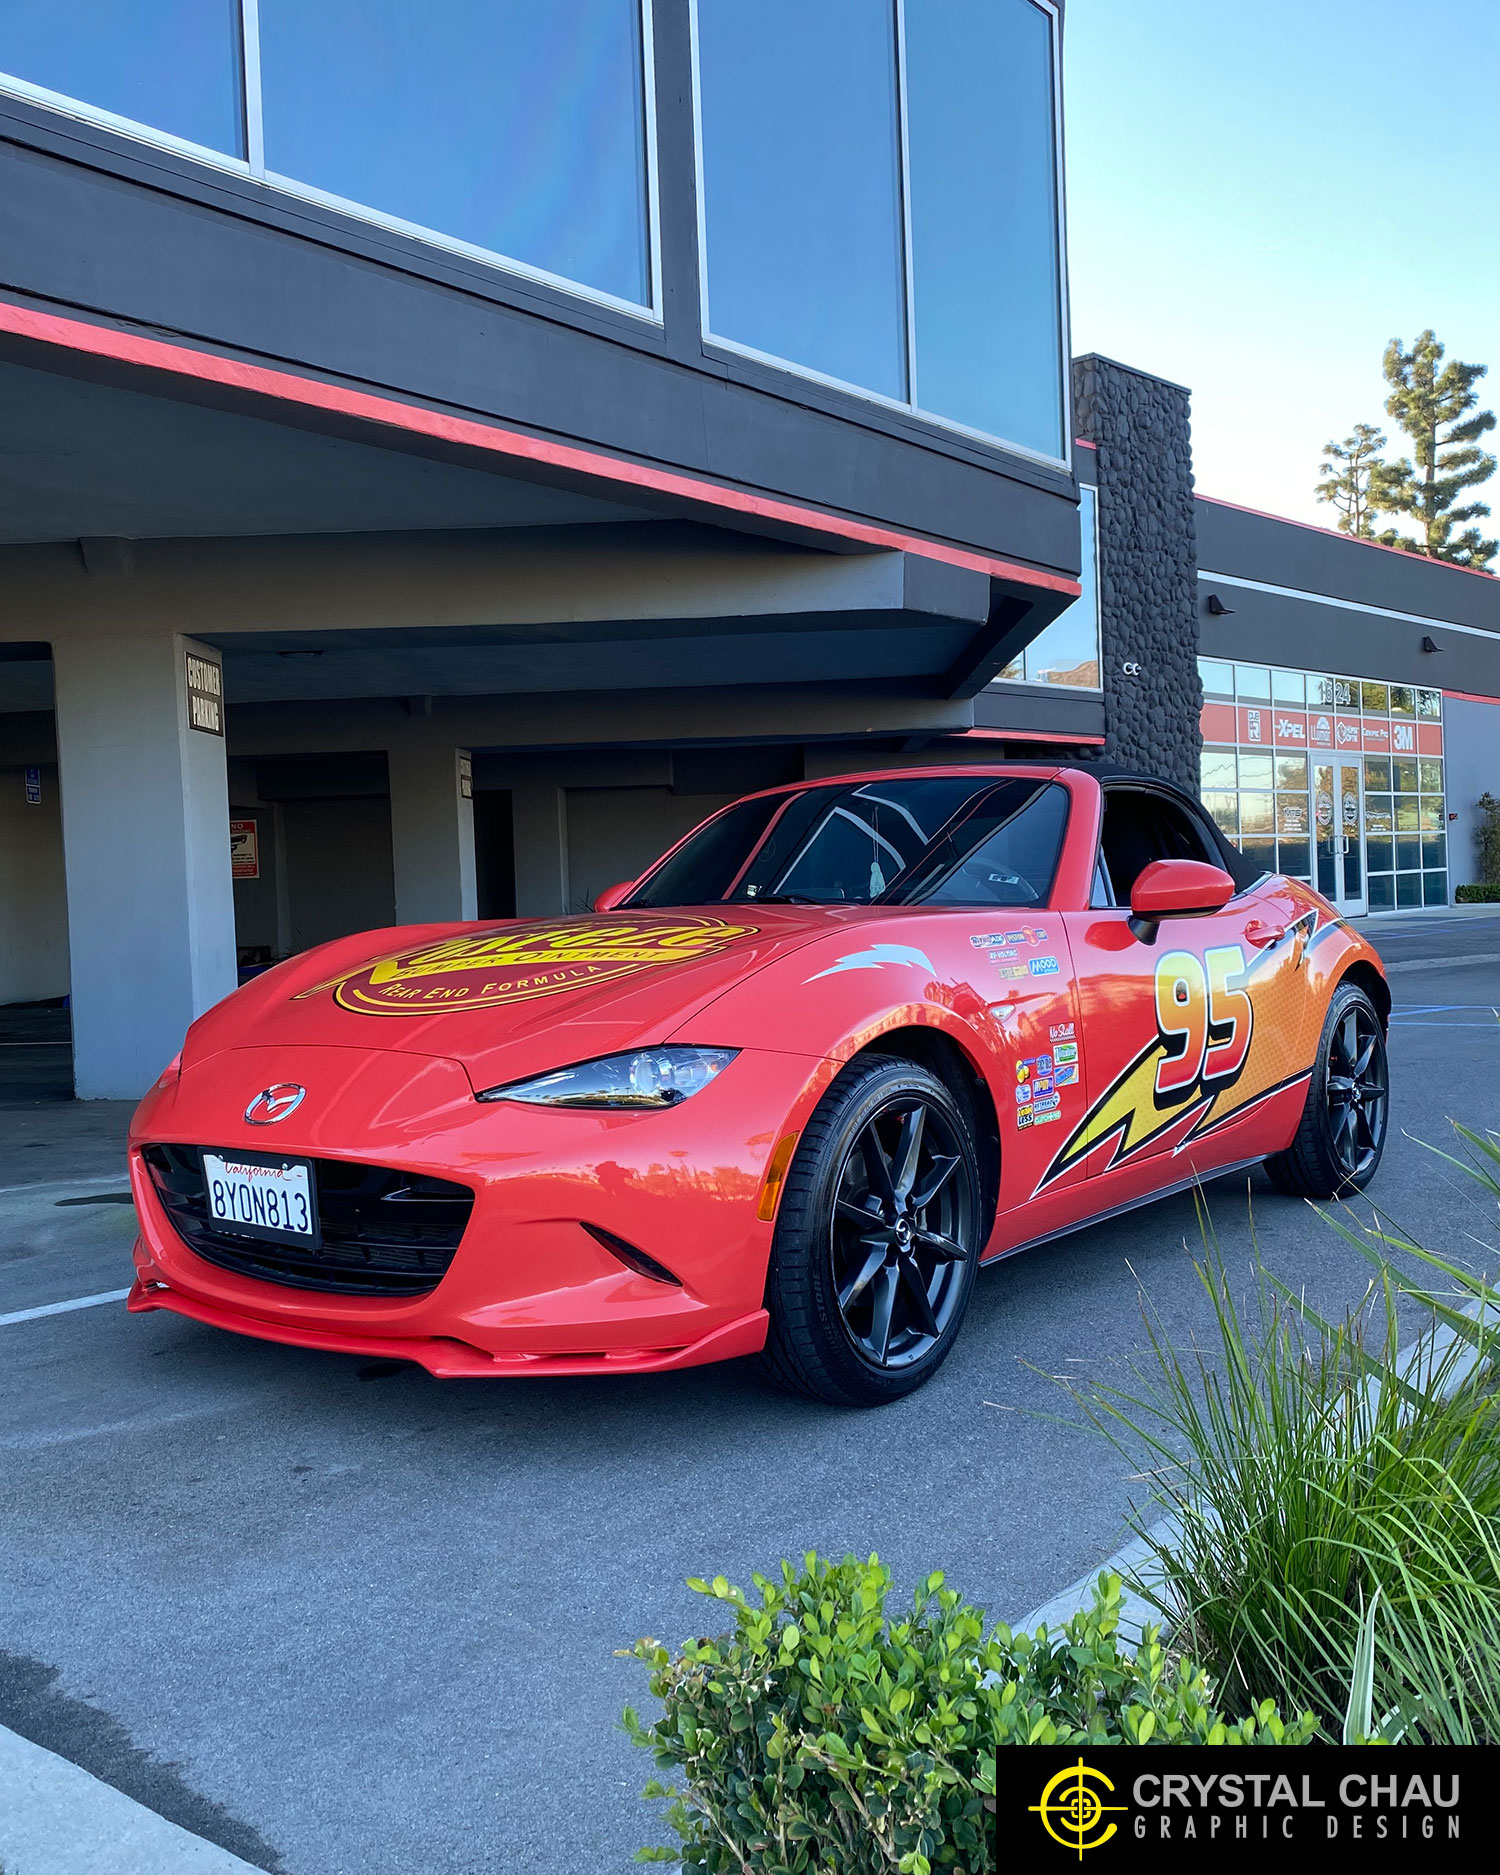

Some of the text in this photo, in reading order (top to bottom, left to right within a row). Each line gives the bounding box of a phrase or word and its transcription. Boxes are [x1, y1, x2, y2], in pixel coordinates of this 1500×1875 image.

[187, 656, 220, 696] CUSTOMER
[1318, 680, 1351, 705] 1624
[192, 695, 219, 731] PARKING
[1278, 718, 1306, 739] XPEL
[1394, 725, 1413, 750] 3M
[390, 951, 667, 979] BUMPER OINTMENT
[1031, 958, 1057, 973] MOOD
[378, 964, 602, 1000] REAR END FORMULA
[1058, 1022, 1075, 1037] Stall
[1155, 944, 1253, 1094] 95
[1018, 1114, 1033, 1125] LESS
